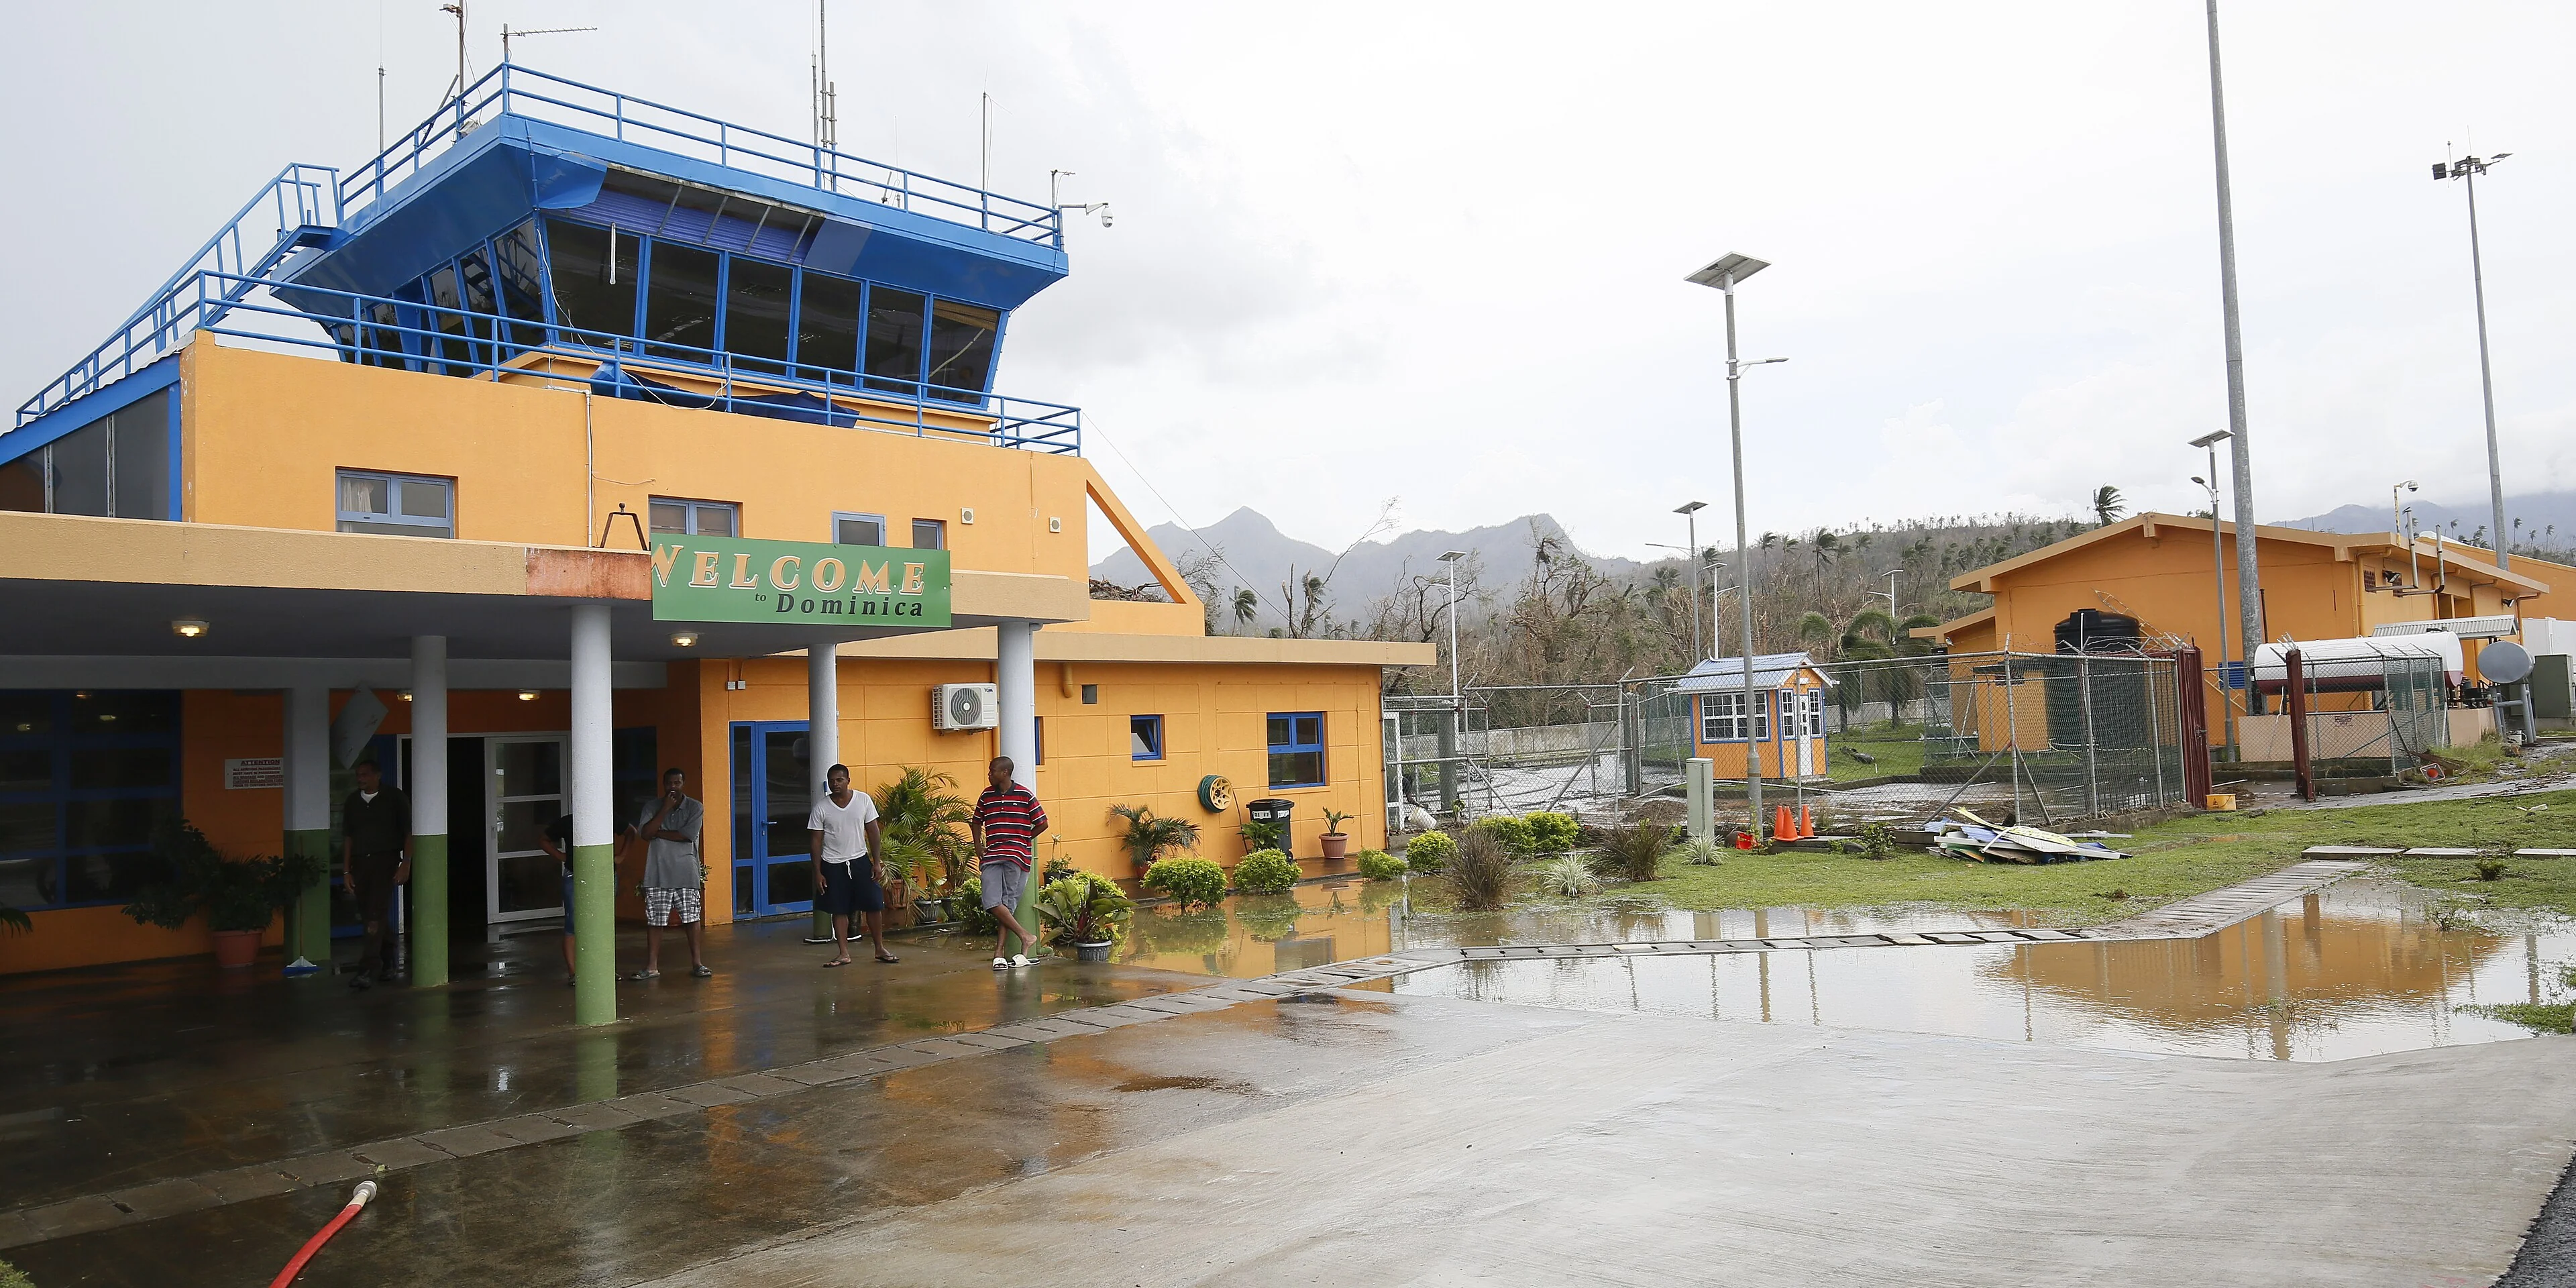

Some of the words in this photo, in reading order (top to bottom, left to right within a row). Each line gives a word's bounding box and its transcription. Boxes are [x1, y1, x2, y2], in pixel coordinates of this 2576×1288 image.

[651, 543, 925, 594] WELCOME
[755, 592, 767, 602] to
[775, 593, 922, 616] Dominica
